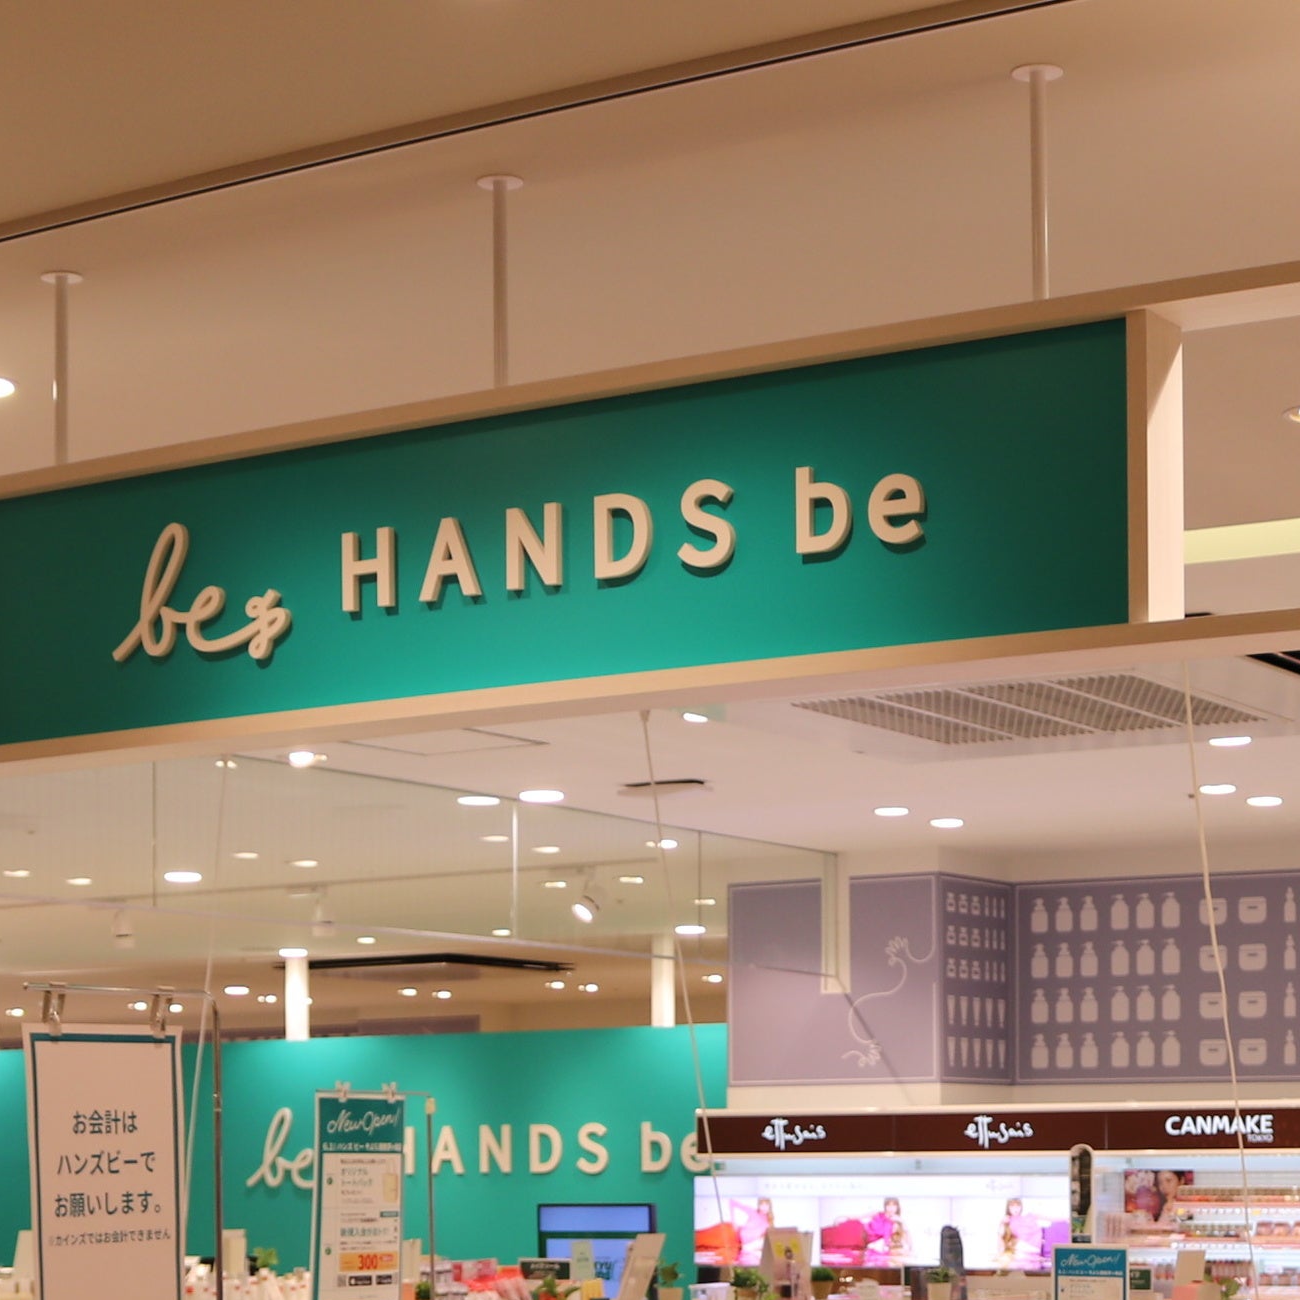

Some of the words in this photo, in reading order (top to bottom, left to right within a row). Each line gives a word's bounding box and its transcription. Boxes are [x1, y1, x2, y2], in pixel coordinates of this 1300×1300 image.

[340, 478, 737, 614] HANDS
[795, 466, 927, 555] be
[72, 1109, 138, 1136] お会計は
[327, 1108, 364, 1134] New
[1164, 1113, 1274, 1136] CANMAKE
[1246, 1132, 1274, 1144] TOKYO
[57, 1150, 157, 1176] ハンズビーで
[54, 1189, 162, 1219] お願いします。
[357, 1254, 379, 1271] 300
